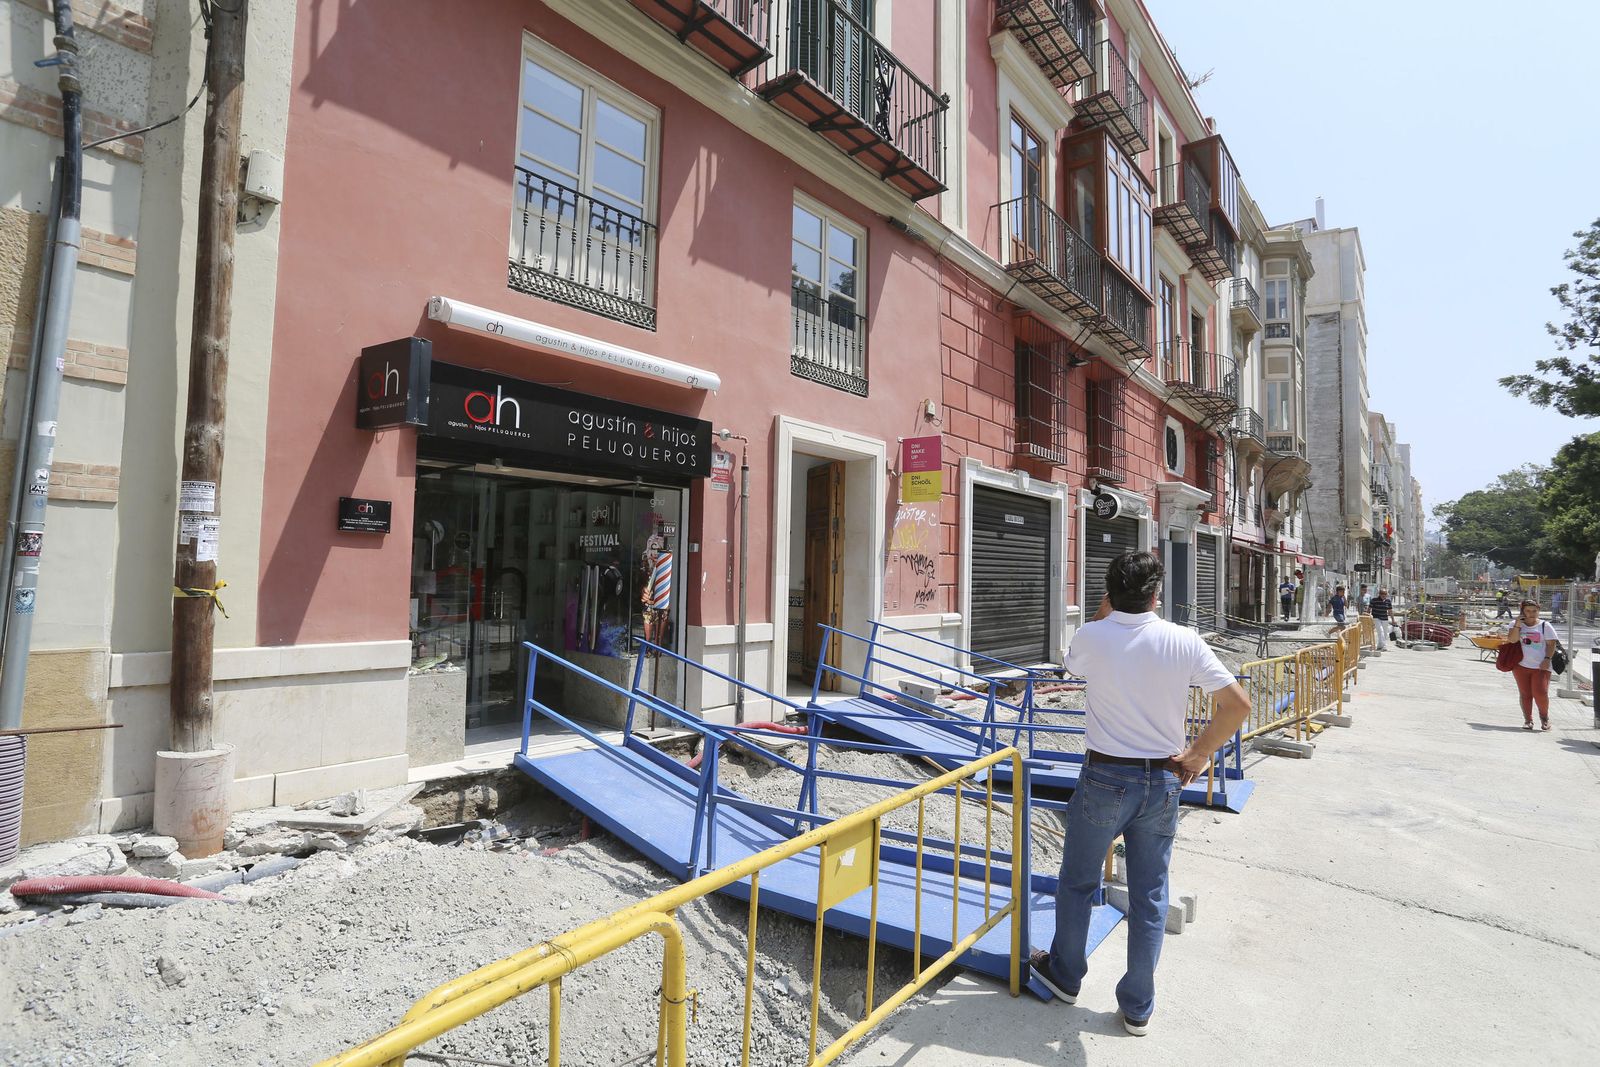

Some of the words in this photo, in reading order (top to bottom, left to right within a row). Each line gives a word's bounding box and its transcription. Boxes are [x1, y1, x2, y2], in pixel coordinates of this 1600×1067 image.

[486, 321, 504, 335] ah
[579, 345, 599, 357] hijos
[601, 352, 666, 374] PELUQUEROS
[367, 361, 400, 402] ah
[686, 374, 699, 386] ah
[464, 384, 520, 429] ah
[487, 427, 531, 439] PELUQUEROS
[568, 410, 636, 436] agustín
[661, 425, 697, 447] hijos
[567, 432, 697, 467] PELUQUEROS
[579, 533, 620, 548] FESTIVAL
